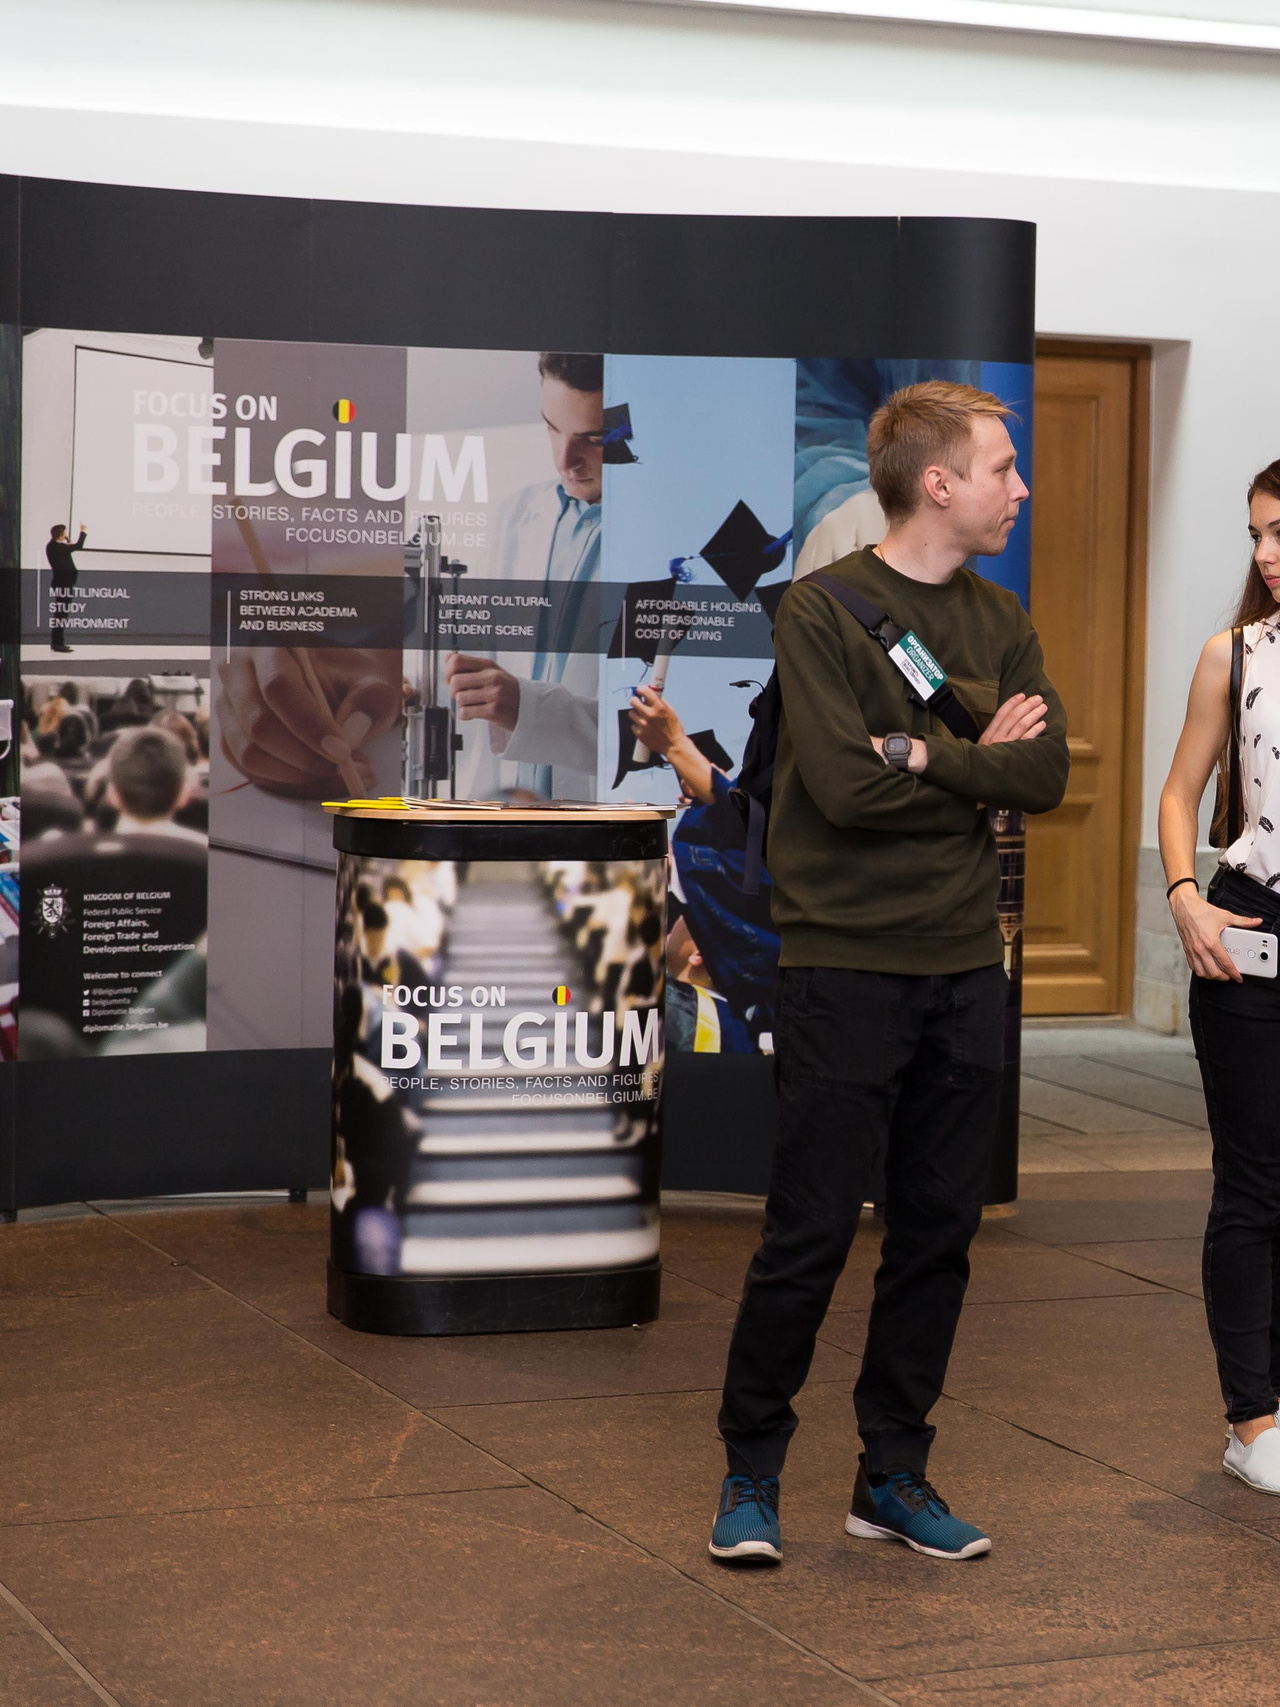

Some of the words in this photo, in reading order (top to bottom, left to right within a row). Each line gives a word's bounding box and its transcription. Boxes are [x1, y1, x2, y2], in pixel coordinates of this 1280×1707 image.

[134, 390, 228, 420] FOCUS
[235, 394, 278, 421] ON
[134, 423, 489, 503] BELGIUM
[213, 505, 295, 522] STORIES,
[302, 507, 358, 523] FACTS
[364, 509, 403, 524] AND
[410, 511, 487, 526] FIGURES
[286, 528, 487, 547] FOCUSONBELGIUM.BE
[49, 587, 130, 598] MULTILINGUAL
[240, 590, 289, 601] STRONG
[291, 591, 325, 602] LINKS
[438, 595, 489, 605] VIBRANT
[491, 596, 552, 607] CULTURAL
[635, 600, 708, 611] AFFORDABLE
[711, 602, 762, 613] HOUSING
[49, 602, 87, 613] STUDY
[240, 605, 295, 616] BETWEEN
[297, 606, 358, 617] ACADEMIA
[438, 609, 463, 619] LIFE
[465, 610, 491, 620] AND
[635, 614, 660, 624] AND
[662, 615, 735, 627] REASONABLE
[49, 618, 130, 628] ENVIRONMENT
[239, 620, 264, 630] AND
[267, 621, 325, 631] BUSINESS
[438, 624, 492, 635] STUDENT
[494, 625, 534, 636] SCENE
[635, 629, 667, 639] COST
[668, 630, 684, 640] OF
[686, 631, 722, 641] LIVING
[906, 646, 935, 681] ORGANIZER
[907, 635, 944, 680] ОРГАНИЗАТОР
[83, 893, 122, 901] KINGDOM
[123, 892, 135, 900] OF
[83, 908, 110, 916] Federal
[112, 907, 134, 915] Public
[83, 920, 115, 929] Foreign
[117, 919, 149, 927] Affairs,
[83, 932, 115, 942] Foreign
[116, 931, 140, 940] Trade
[142, 931, 159, 939] and
[83, 945, 140, 954] Development
[142, 943, 195, 952] Cooperation
[83, 972, 119, 980] Welcome
[131, 970, 163, 978] connect
[382, 984, 464, 1007] FOCUS
[471, 986, 506, 1007] ON
[381, 1008, 659, 1070] BELGIUM
[381, 1077, 444, 1091] PEOPLE,
[450, 1077, 519, 1090] STORIES,
[525, 1076, 572, 1088] FACTS
[577, 1075, 608, 1087] AND
[613, 1071, 659, 1086] FIGURES
[512, 1088, 658, 1106] FOCUSONBELGIUM.BE
